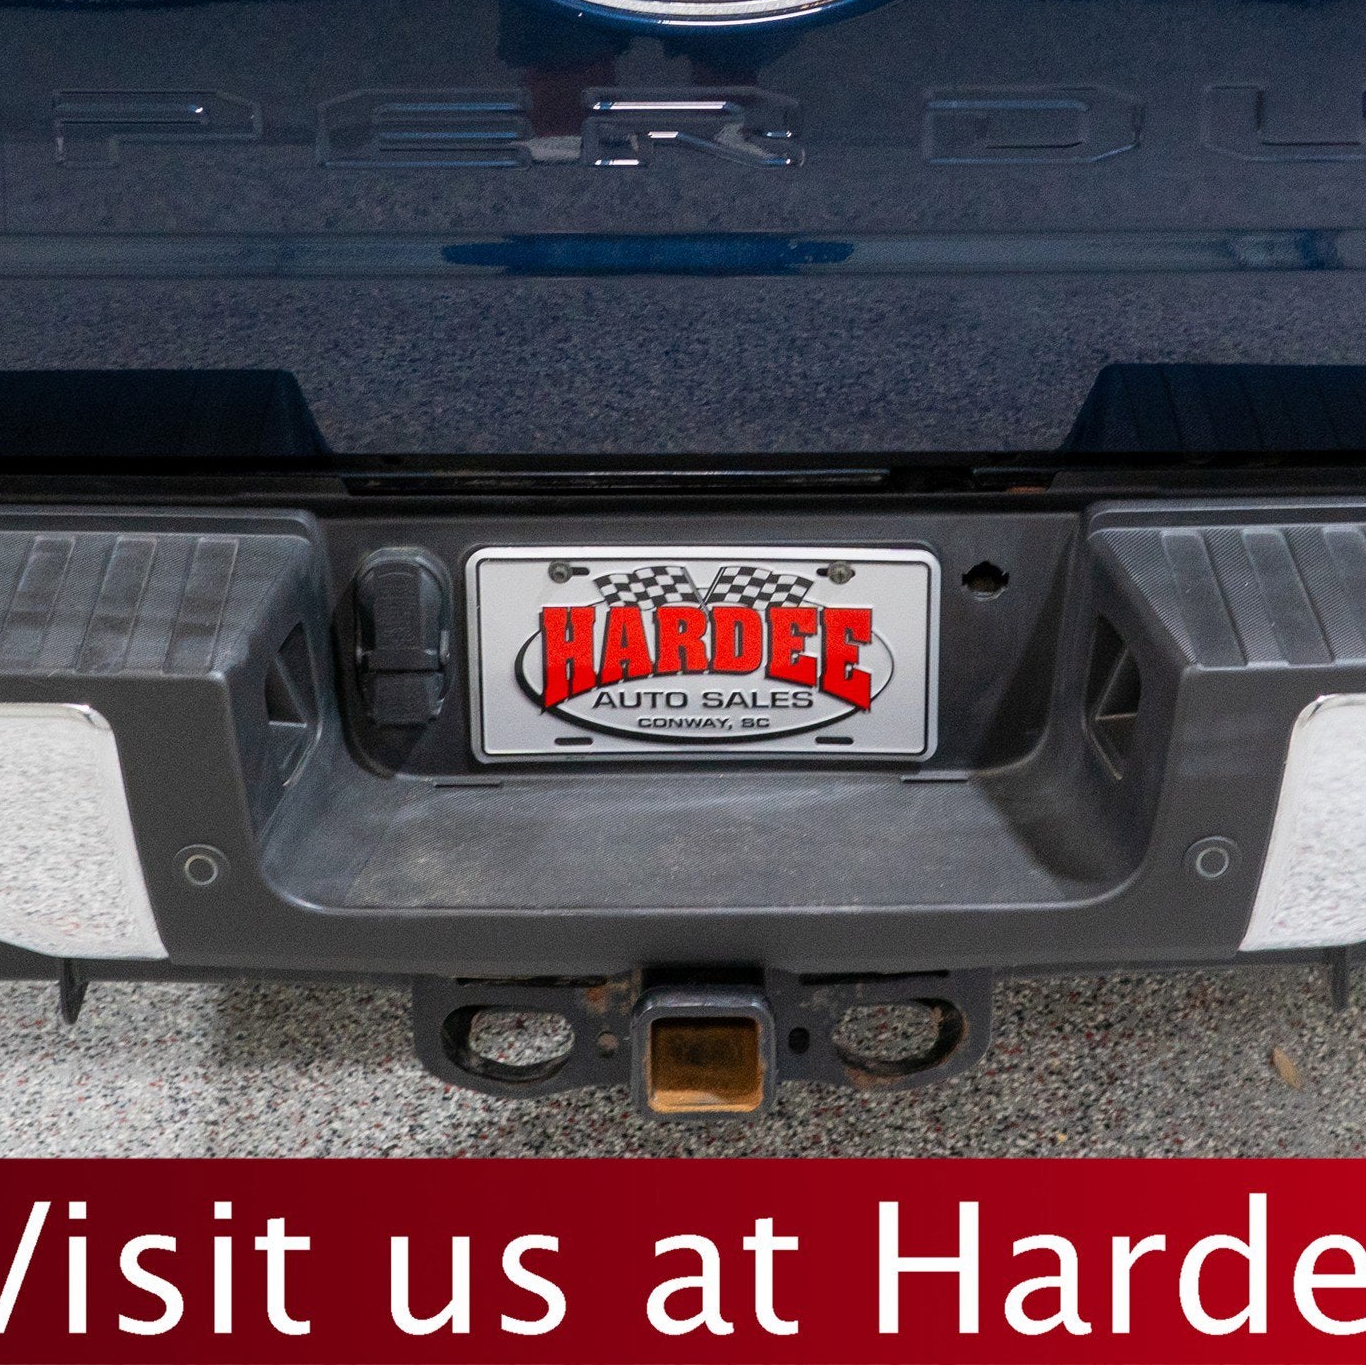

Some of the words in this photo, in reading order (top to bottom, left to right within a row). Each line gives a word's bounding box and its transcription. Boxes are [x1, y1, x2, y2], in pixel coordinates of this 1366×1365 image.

[539, 606, 873, 714] HARDEE
[592, 691, 689, 710] AUTO
[702, 690, 815, 710] SALES
[637, 717, 733, 731] CONWAY,
[741, 717, 770, 729] SC
